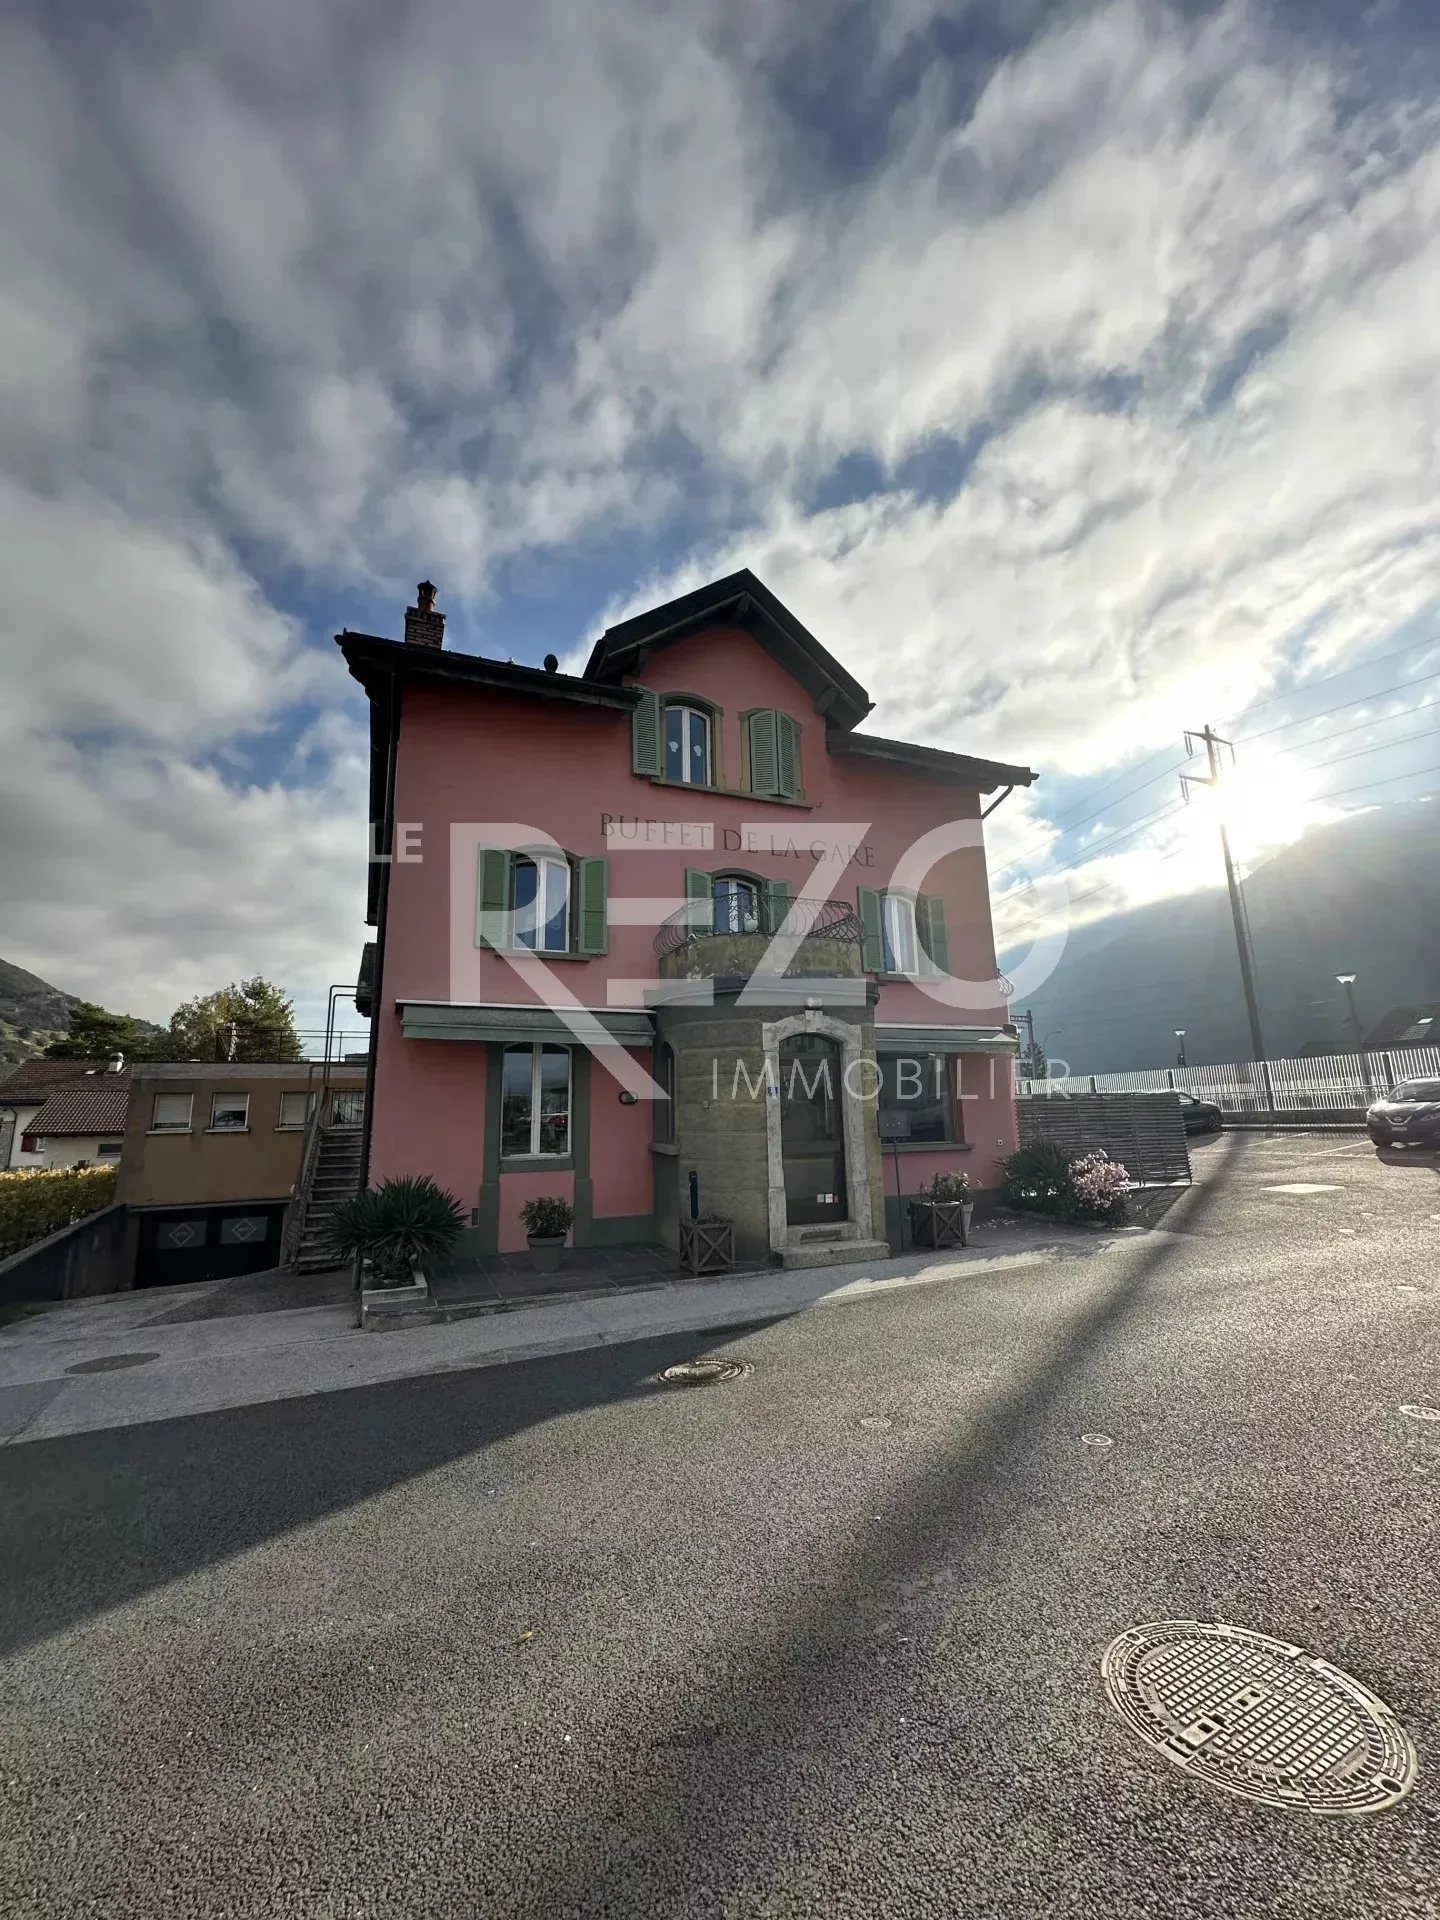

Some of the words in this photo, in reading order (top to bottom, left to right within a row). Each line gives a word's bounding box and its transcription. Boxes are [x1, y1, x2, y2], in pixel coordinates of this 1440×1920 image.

[600, 813, 712, 848] BUFFET
[723, 828, 759, 853] DE
[770, 834, 801, 859] LA
[810, 840, 876, 867] GARE
